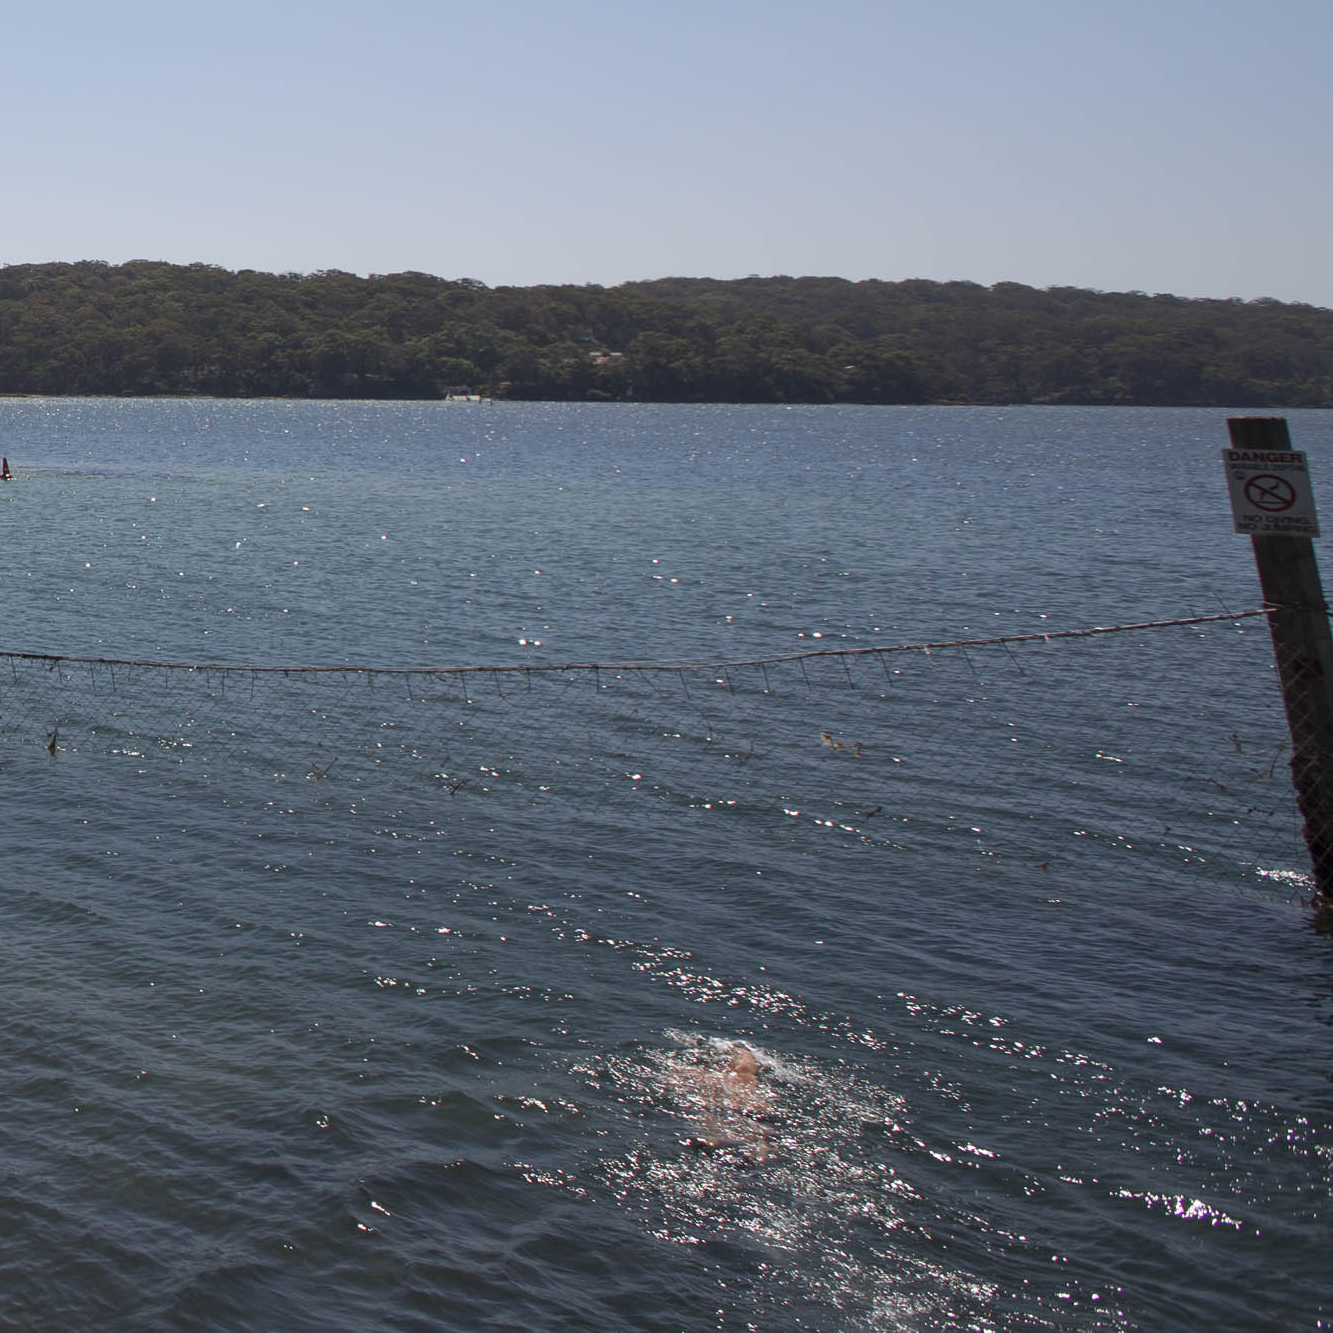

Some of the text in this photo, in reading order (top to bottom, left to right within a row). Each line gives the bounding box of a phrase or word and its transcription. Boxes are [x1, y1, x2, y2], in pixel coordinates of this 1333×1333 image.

[1229, 452, 1302, 463] DANGER
[1244, 514, 1309, 525] NO DIVING
[1237, 523, 1258, 531] NO
